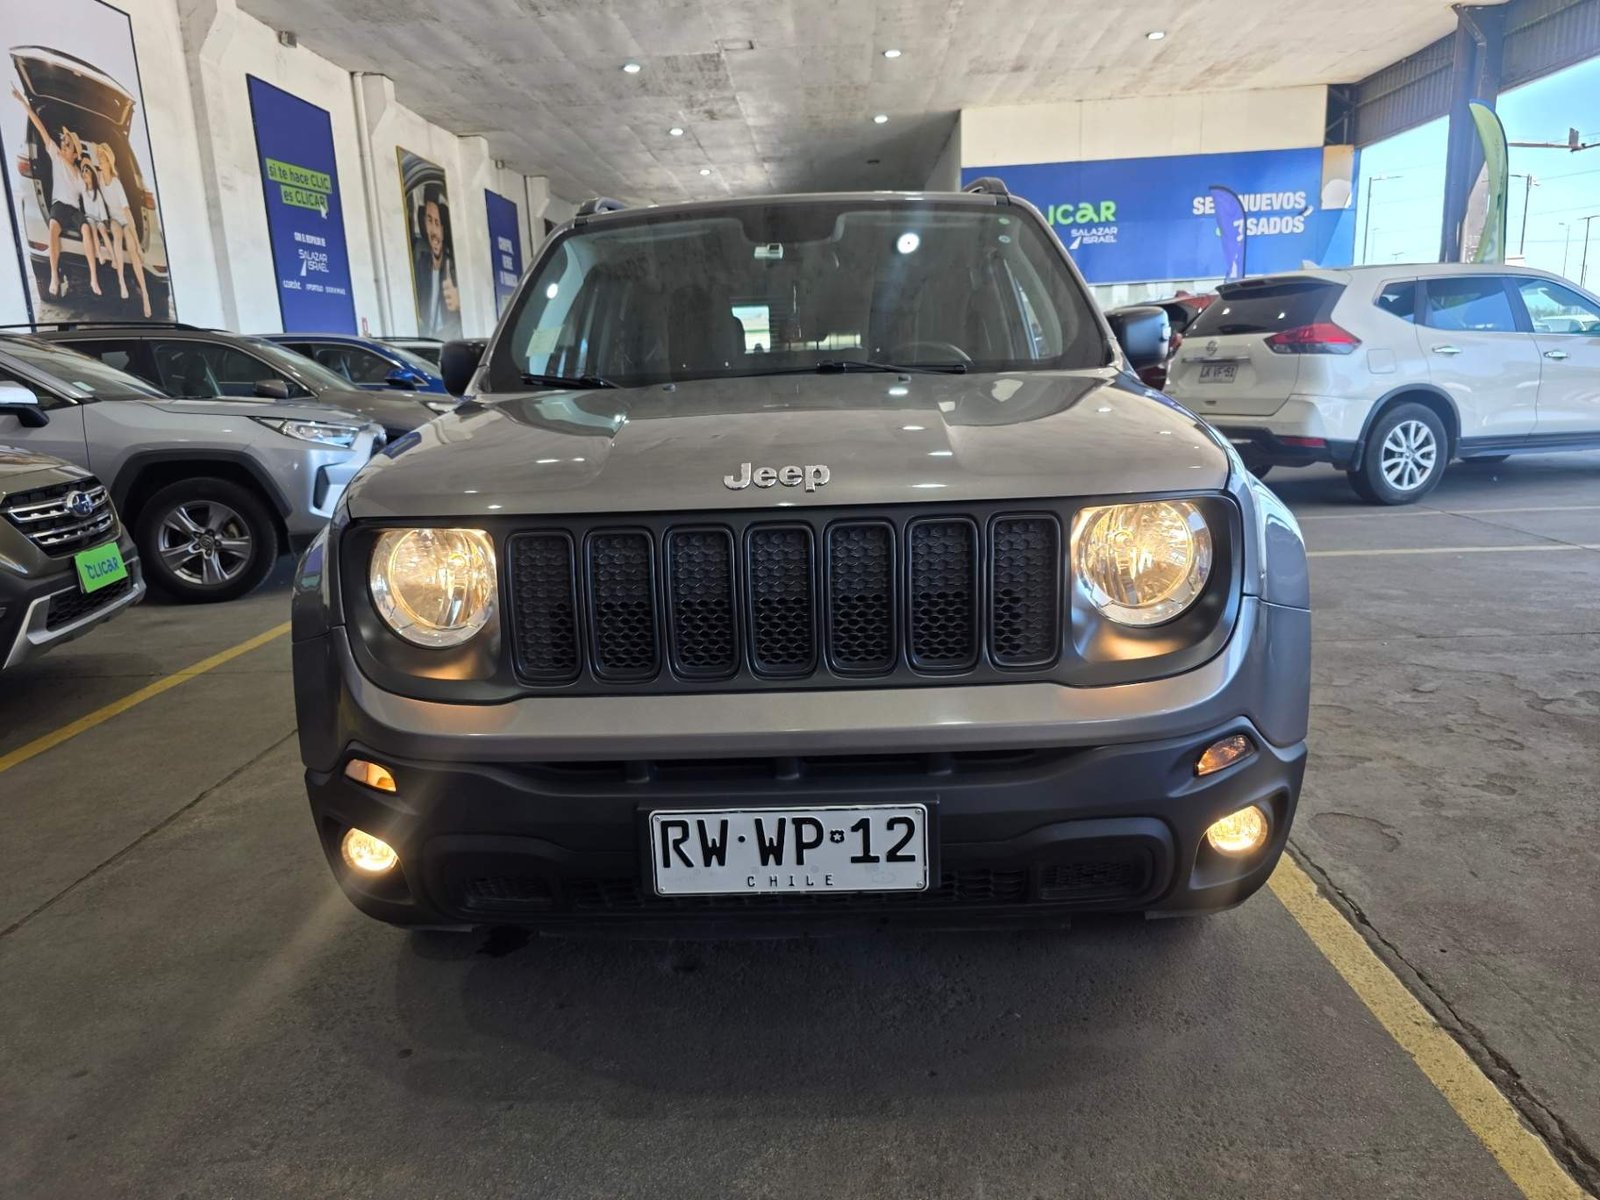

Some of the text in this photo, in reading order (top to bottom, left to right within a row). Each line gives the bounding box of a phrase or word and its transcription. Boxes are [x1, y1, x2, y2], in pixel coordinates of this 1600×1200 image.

[1070, 226, 1118, 237] SALAZAR
[723, 462, 831, 493] Jeep
[746, 875, 834, 888] CHILE
